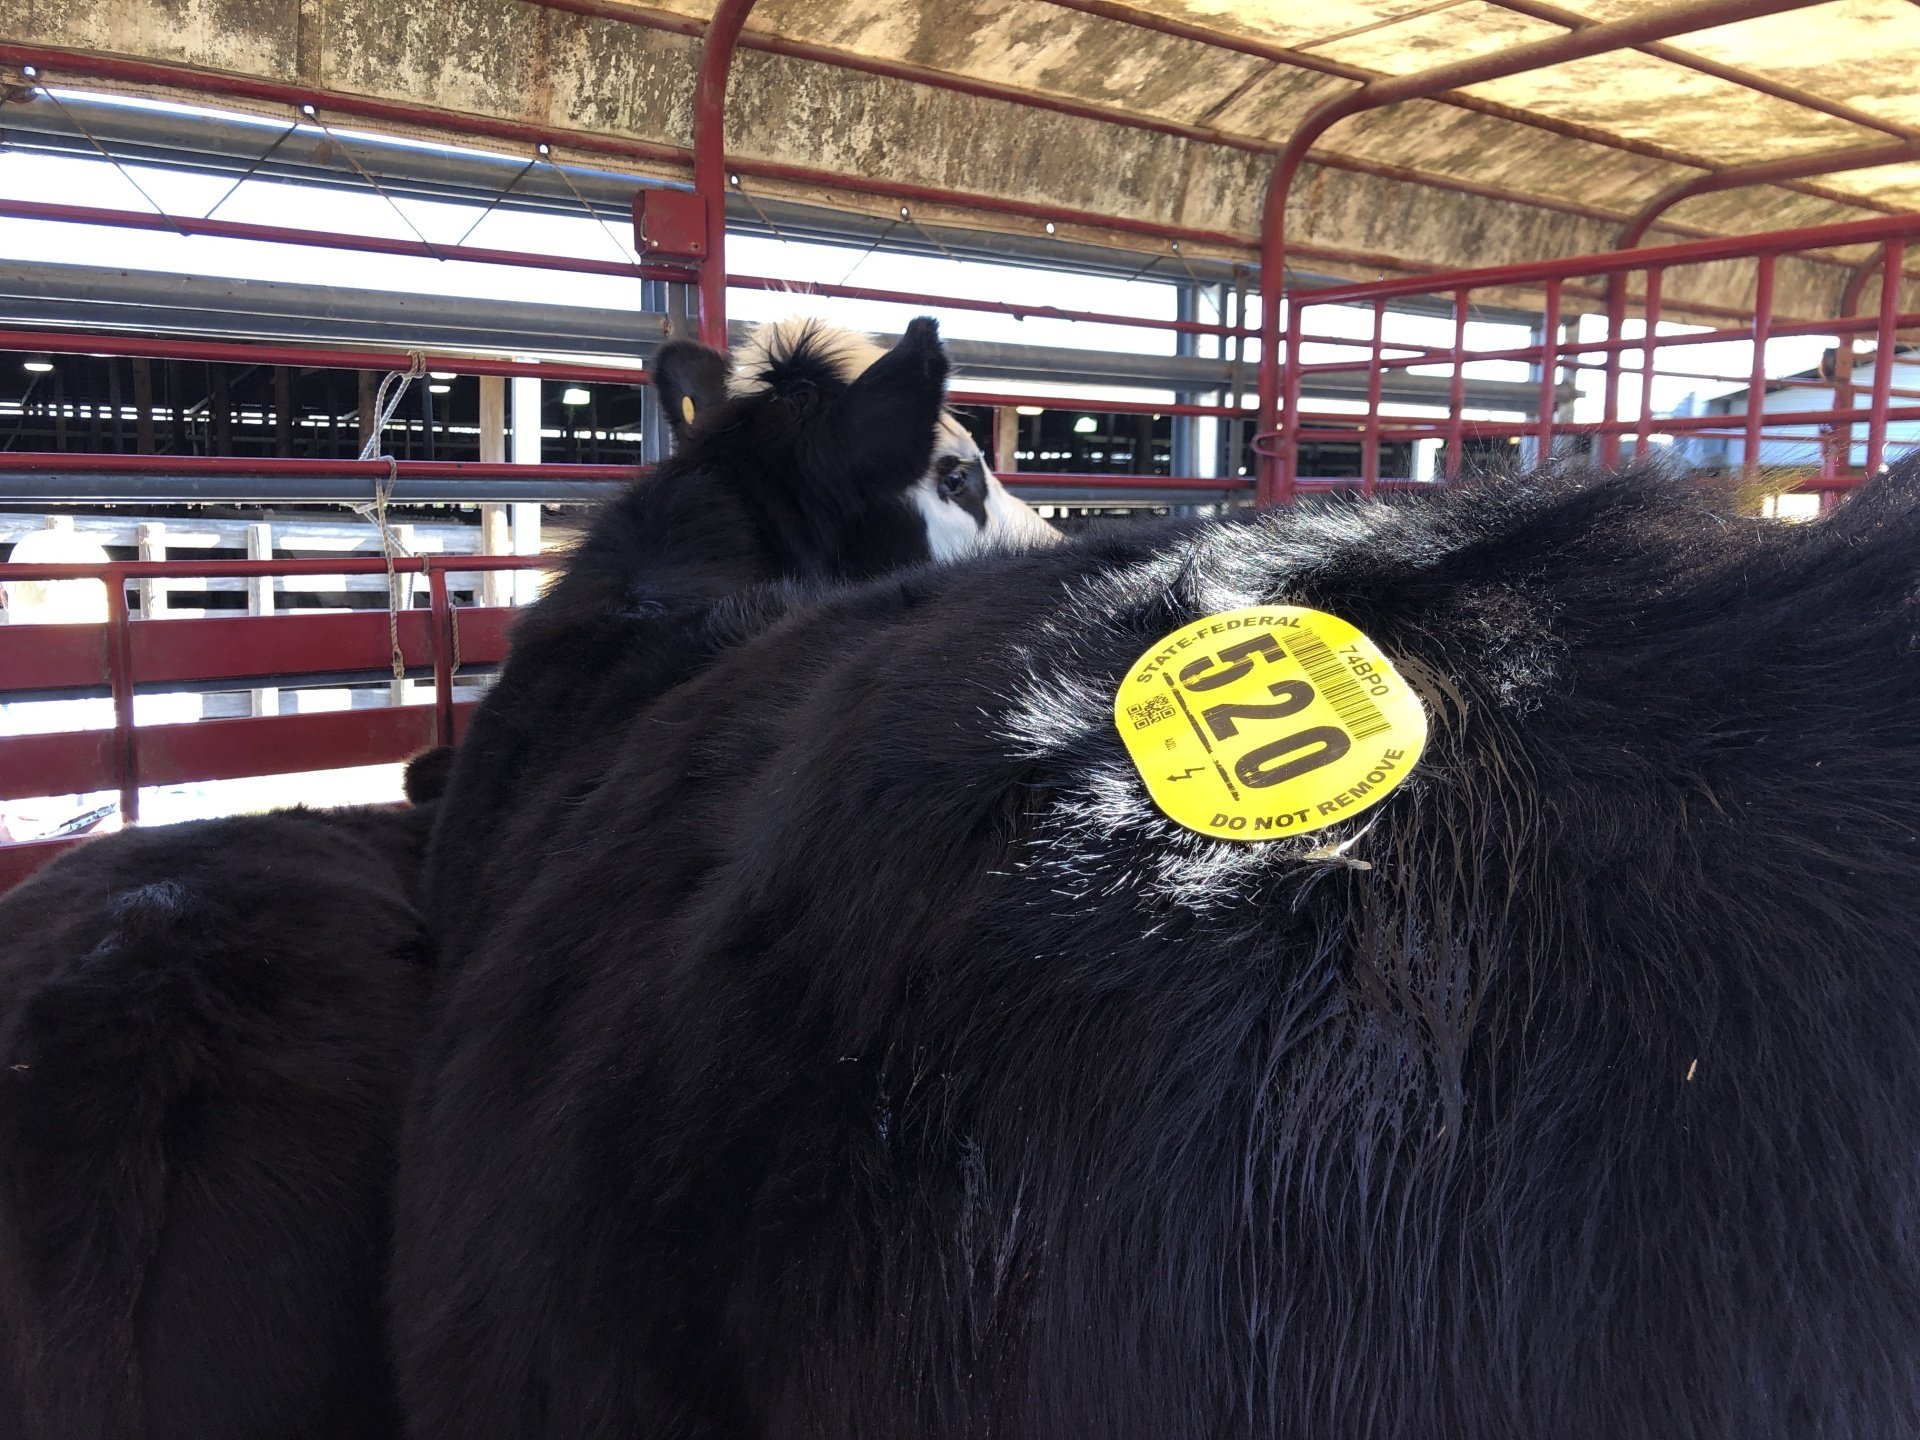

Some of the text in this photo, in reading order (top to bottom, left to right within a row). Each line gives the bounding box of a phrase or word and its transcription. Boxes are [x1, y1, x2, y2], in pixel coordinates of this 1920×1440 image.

[1136, 615, 1302, 684] STATE-FEDERAL
[1178, 632, 1351, 789] 520
[1209, 748, 1404, 831] DO NOT REMOVE
